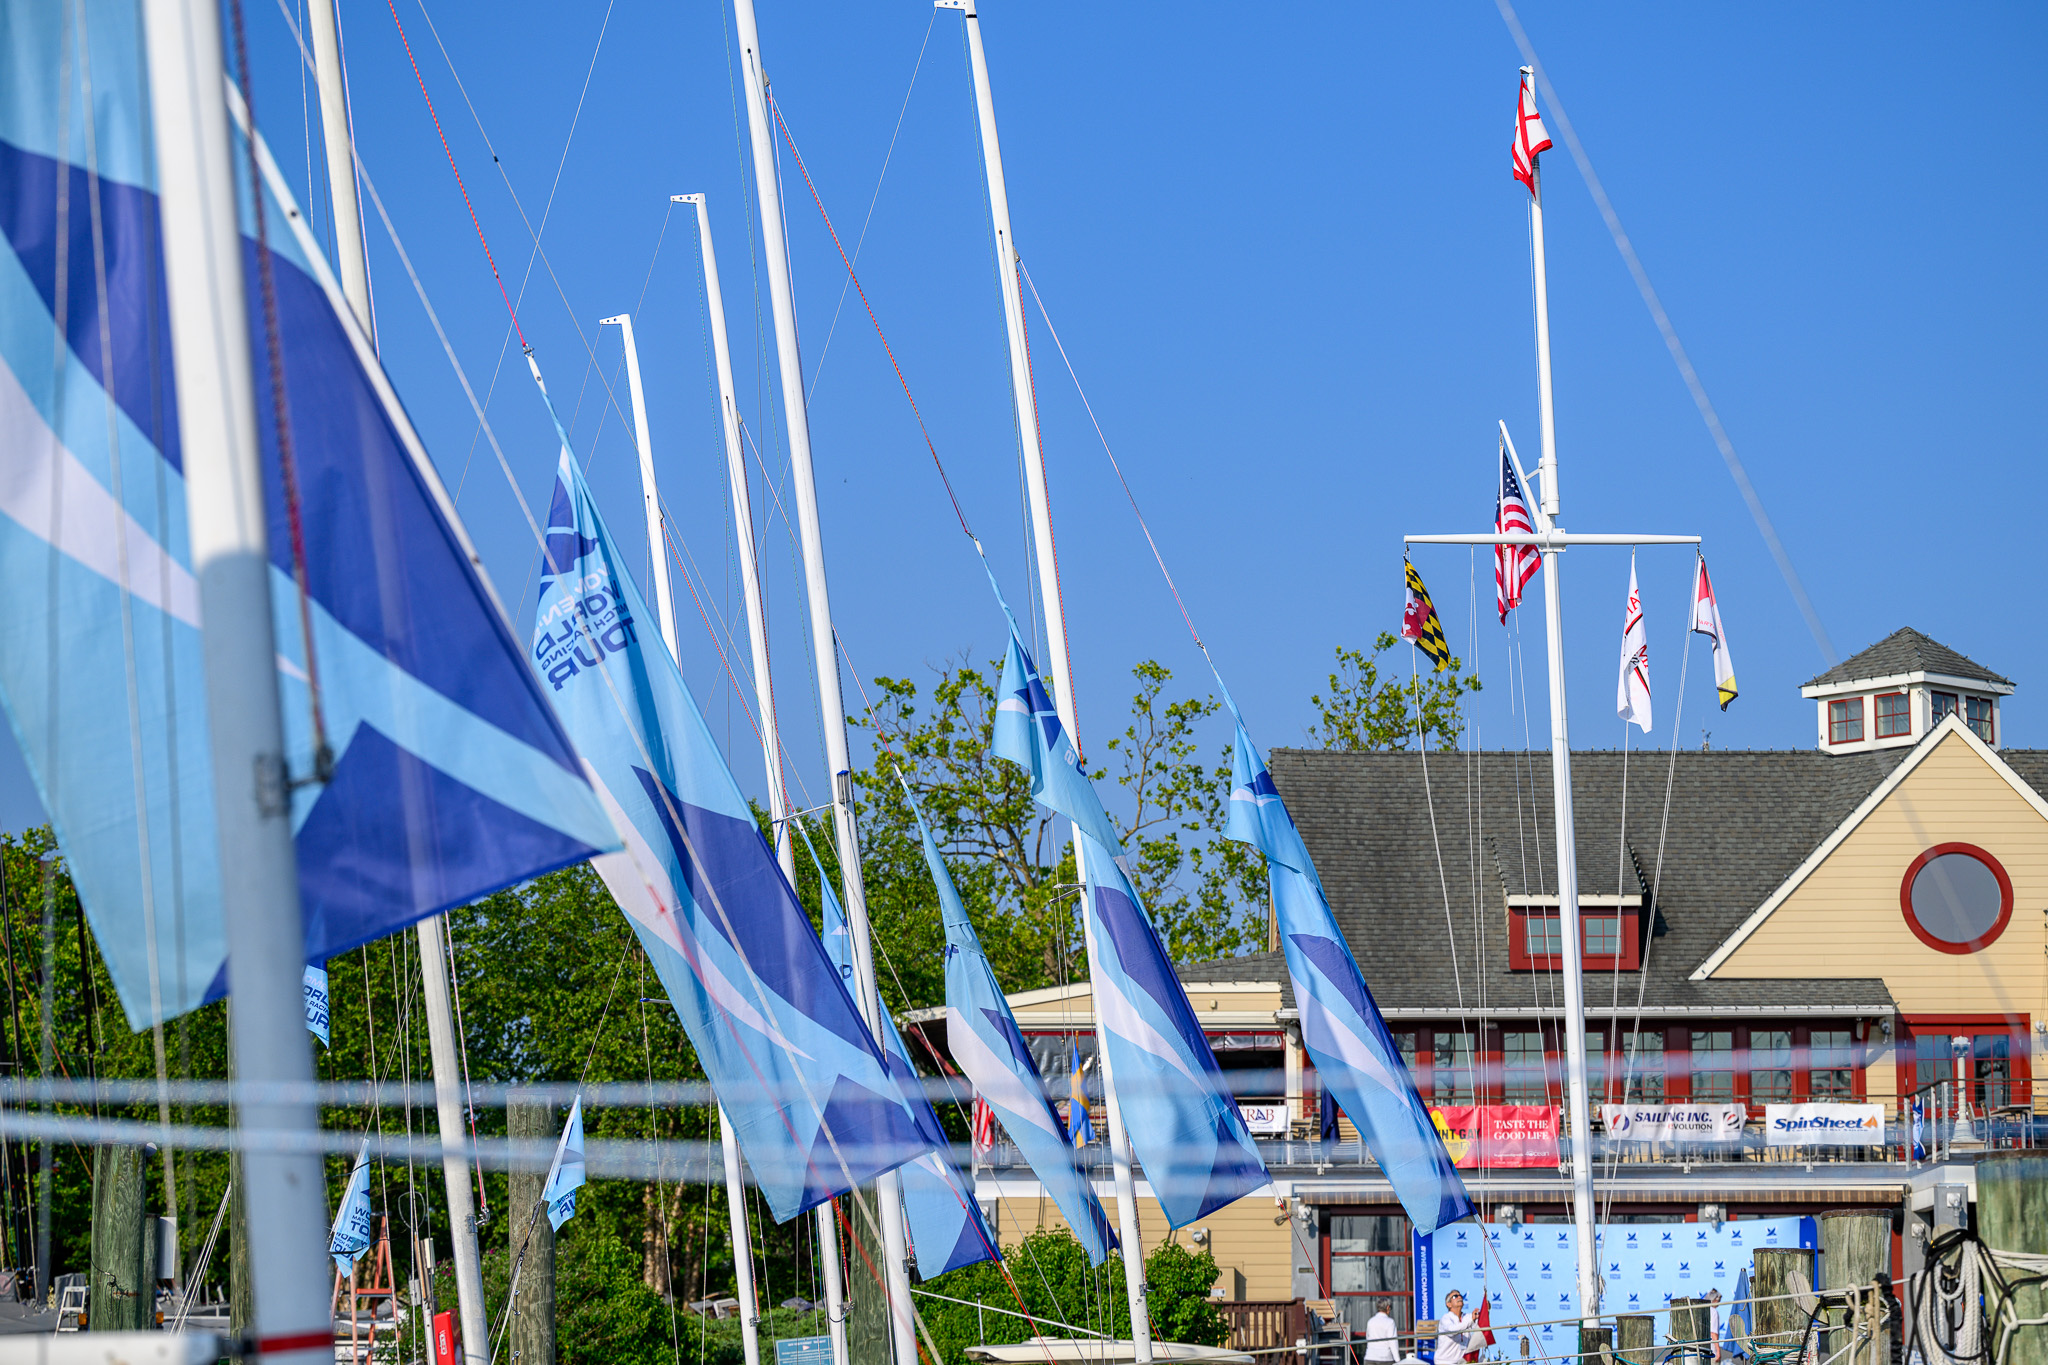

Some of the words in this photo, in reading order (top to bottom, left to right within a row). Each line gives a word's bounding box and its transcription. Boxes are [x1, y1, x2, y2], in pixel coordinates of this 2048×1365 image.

[305, 1007, 330, 1029] UR
[1241, 1108, 1275, 1121] RAB
[1635, 1112, 1685, 1122] SAILING
[1687, 1112, 1713, 1122] INC.
[1493, 1119, 1525, 1129] TASTE
[1526, 1119, 1549, 1129] THE
[1774, 1116, 1864, 1132] SpinSheet
[1459, 1128, 1481, 1140] GAY
[1493, 1131, 1526, 1140] GOOD
[1527, 1131, 1549, 1140] LIFE
